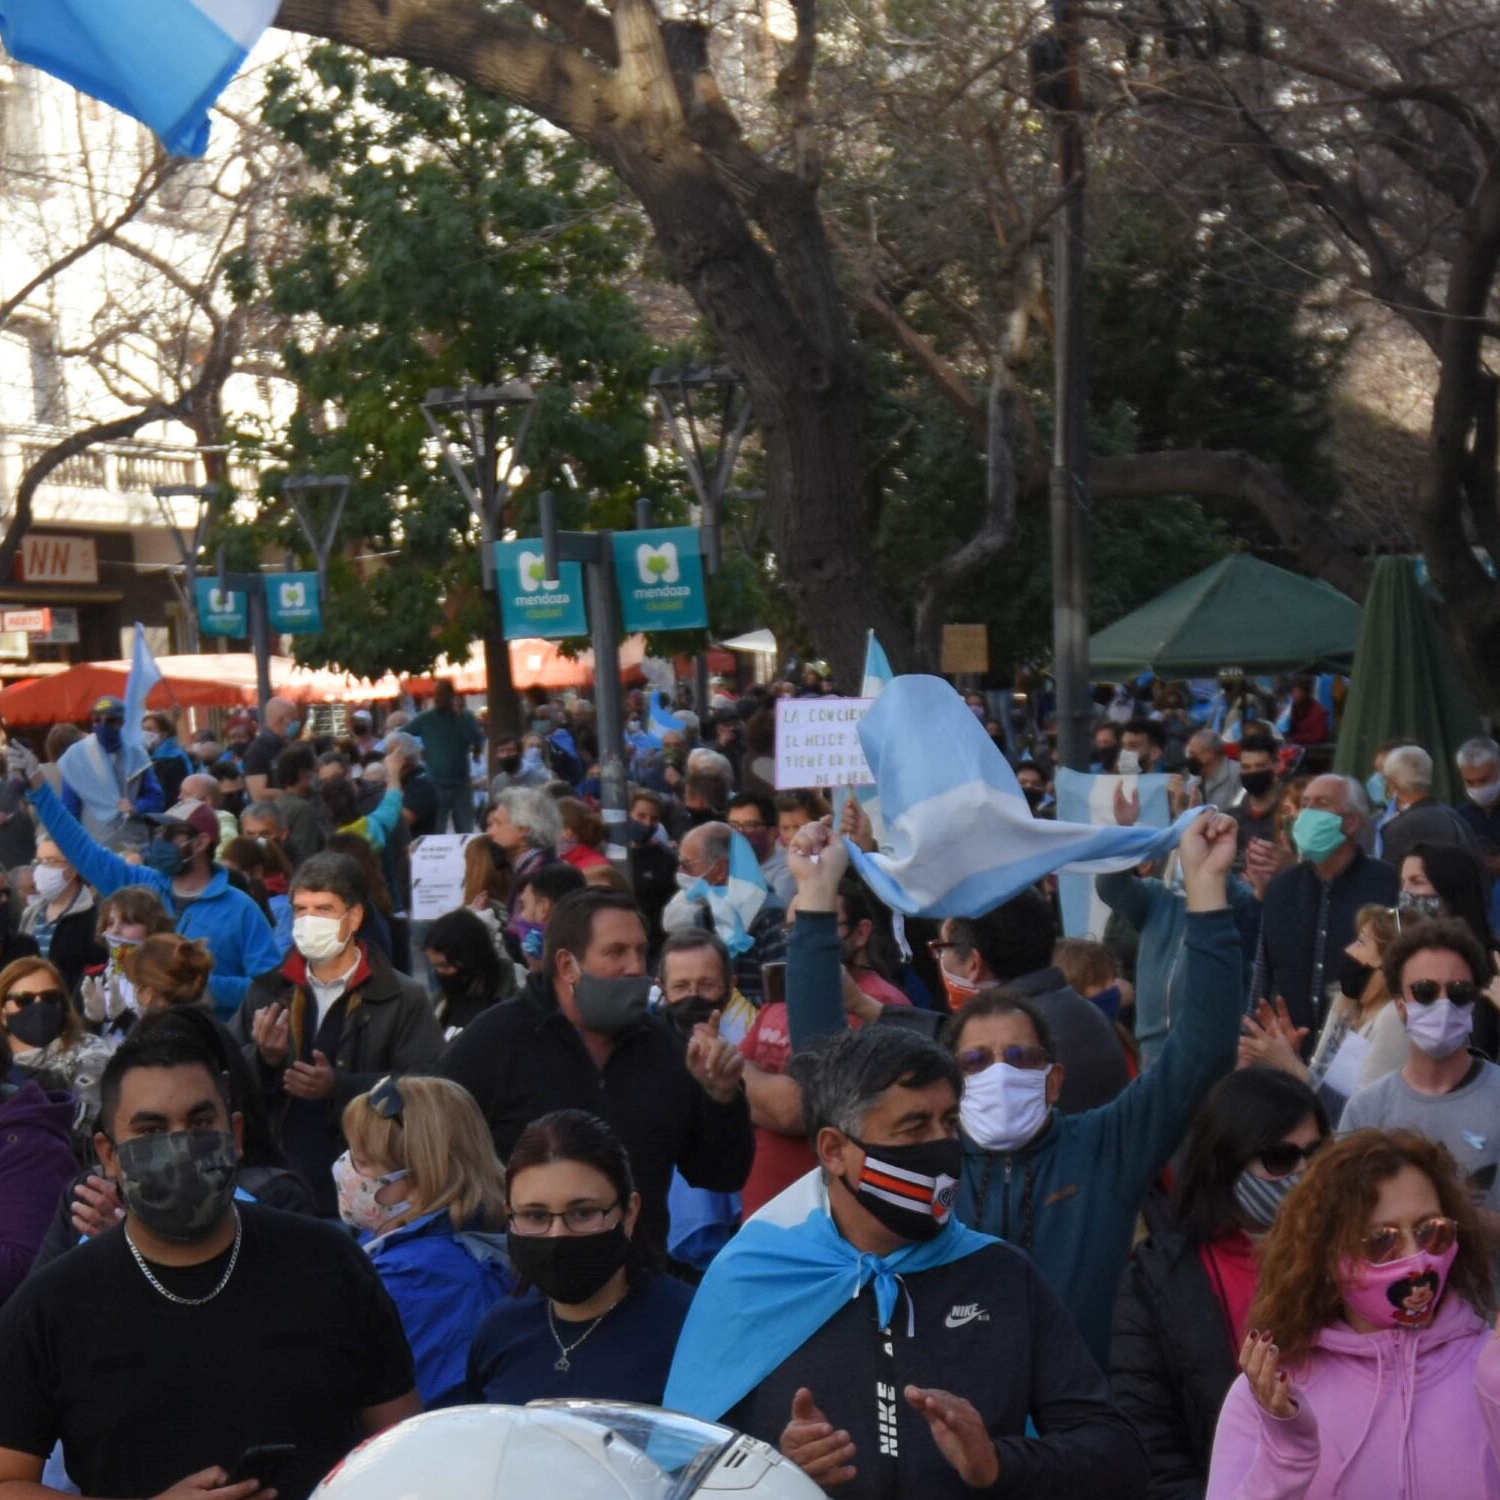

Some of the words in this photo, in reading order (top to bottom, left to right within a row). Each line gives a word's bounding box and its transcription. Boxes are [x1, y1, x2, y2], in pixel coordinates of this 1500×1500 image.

[635, 585, 691, 598] mendoza
[515, 592, 569, 606] mendoza
[951, 1302, 979, 1317] NIKE
[876, 1381, 899, 1457] NIKE
